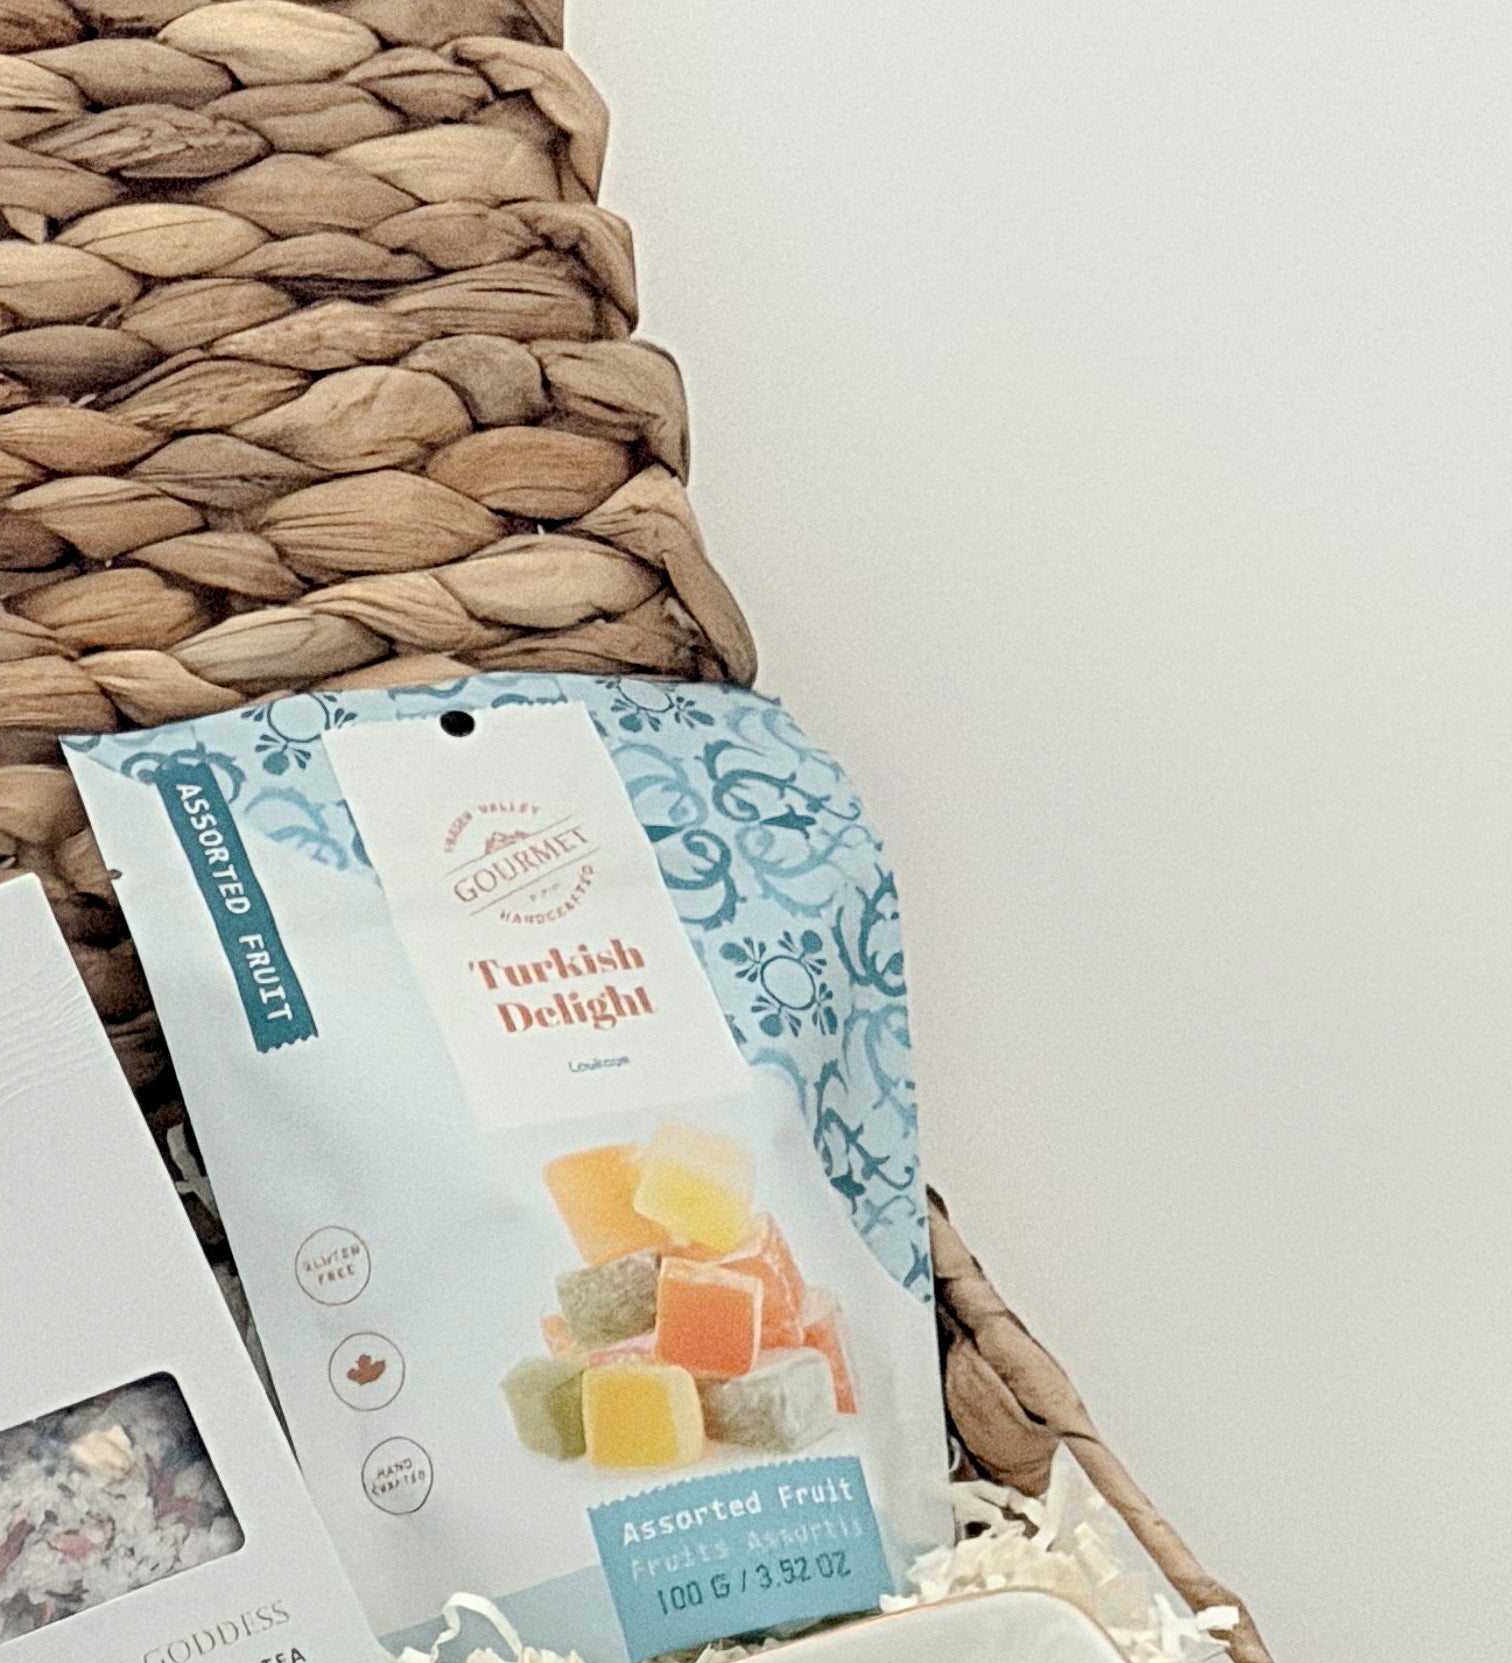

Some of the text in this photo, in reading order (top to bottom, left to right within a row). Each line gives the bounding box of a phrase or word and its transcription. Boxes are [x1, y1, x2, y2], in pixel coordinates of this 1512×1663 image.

[478, 801, 540, 815] VALLEY
[453, 826, 588, 902] GOURMET
[500, 864, 595, 924] HANDCRAFTED
[175, 783, 293, 1021] ASSORTED FRUIT
[468, 938, 646, 991] Turkish
[497, 985, 655, 1033] Delight
[622, 1478, 854, 1546] Assorted Fruit
[631, 1540, 730, 1581] Fruits
[657, 1551, 852, 1615] 100 G / 3.52 OZ
